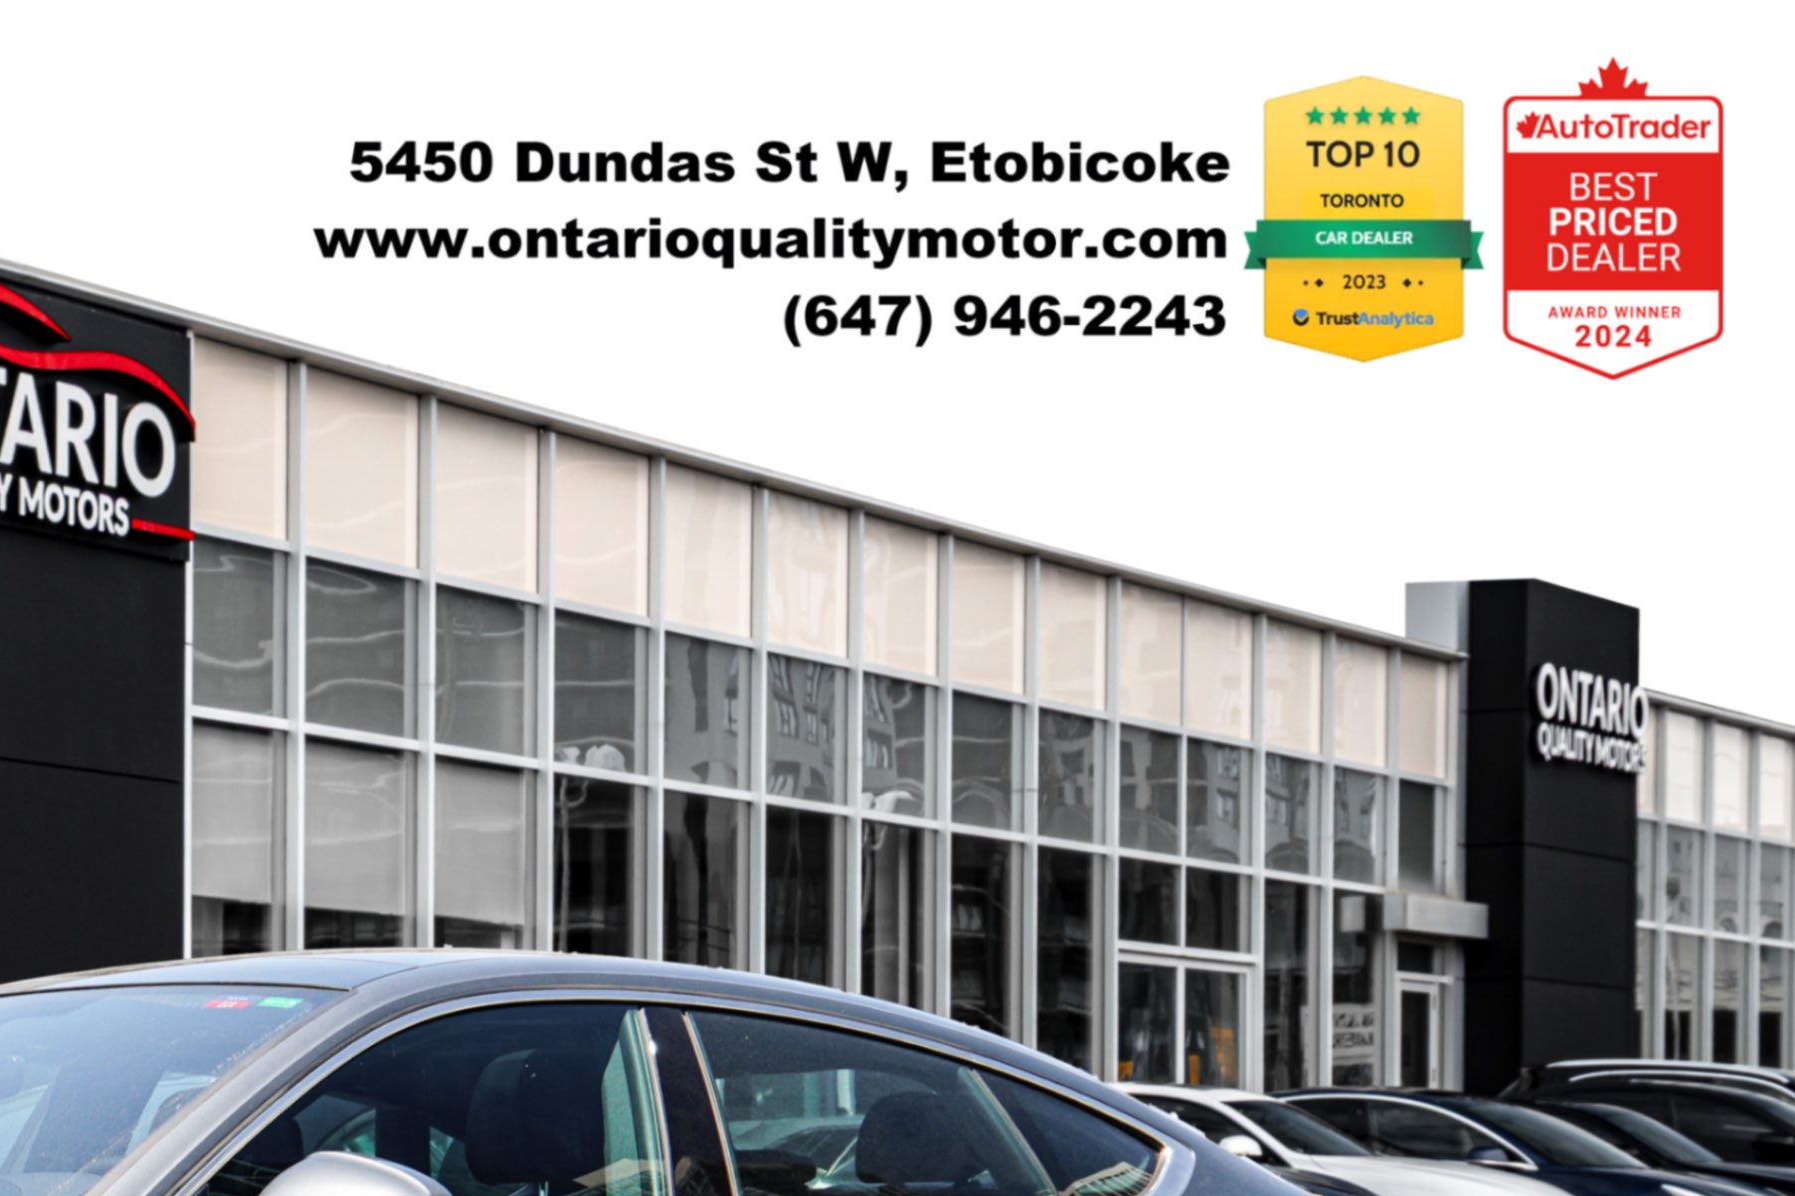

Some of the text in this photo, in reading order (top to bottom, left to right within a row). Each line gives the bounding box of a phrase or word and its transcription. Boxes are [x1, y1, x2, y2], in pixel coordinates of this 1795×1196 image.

[19, 475, 131, 537] MOTORS
[1536, 662, 1648, 740] ONTARIO
[1537, 722, 1594, 763] QUALITY
